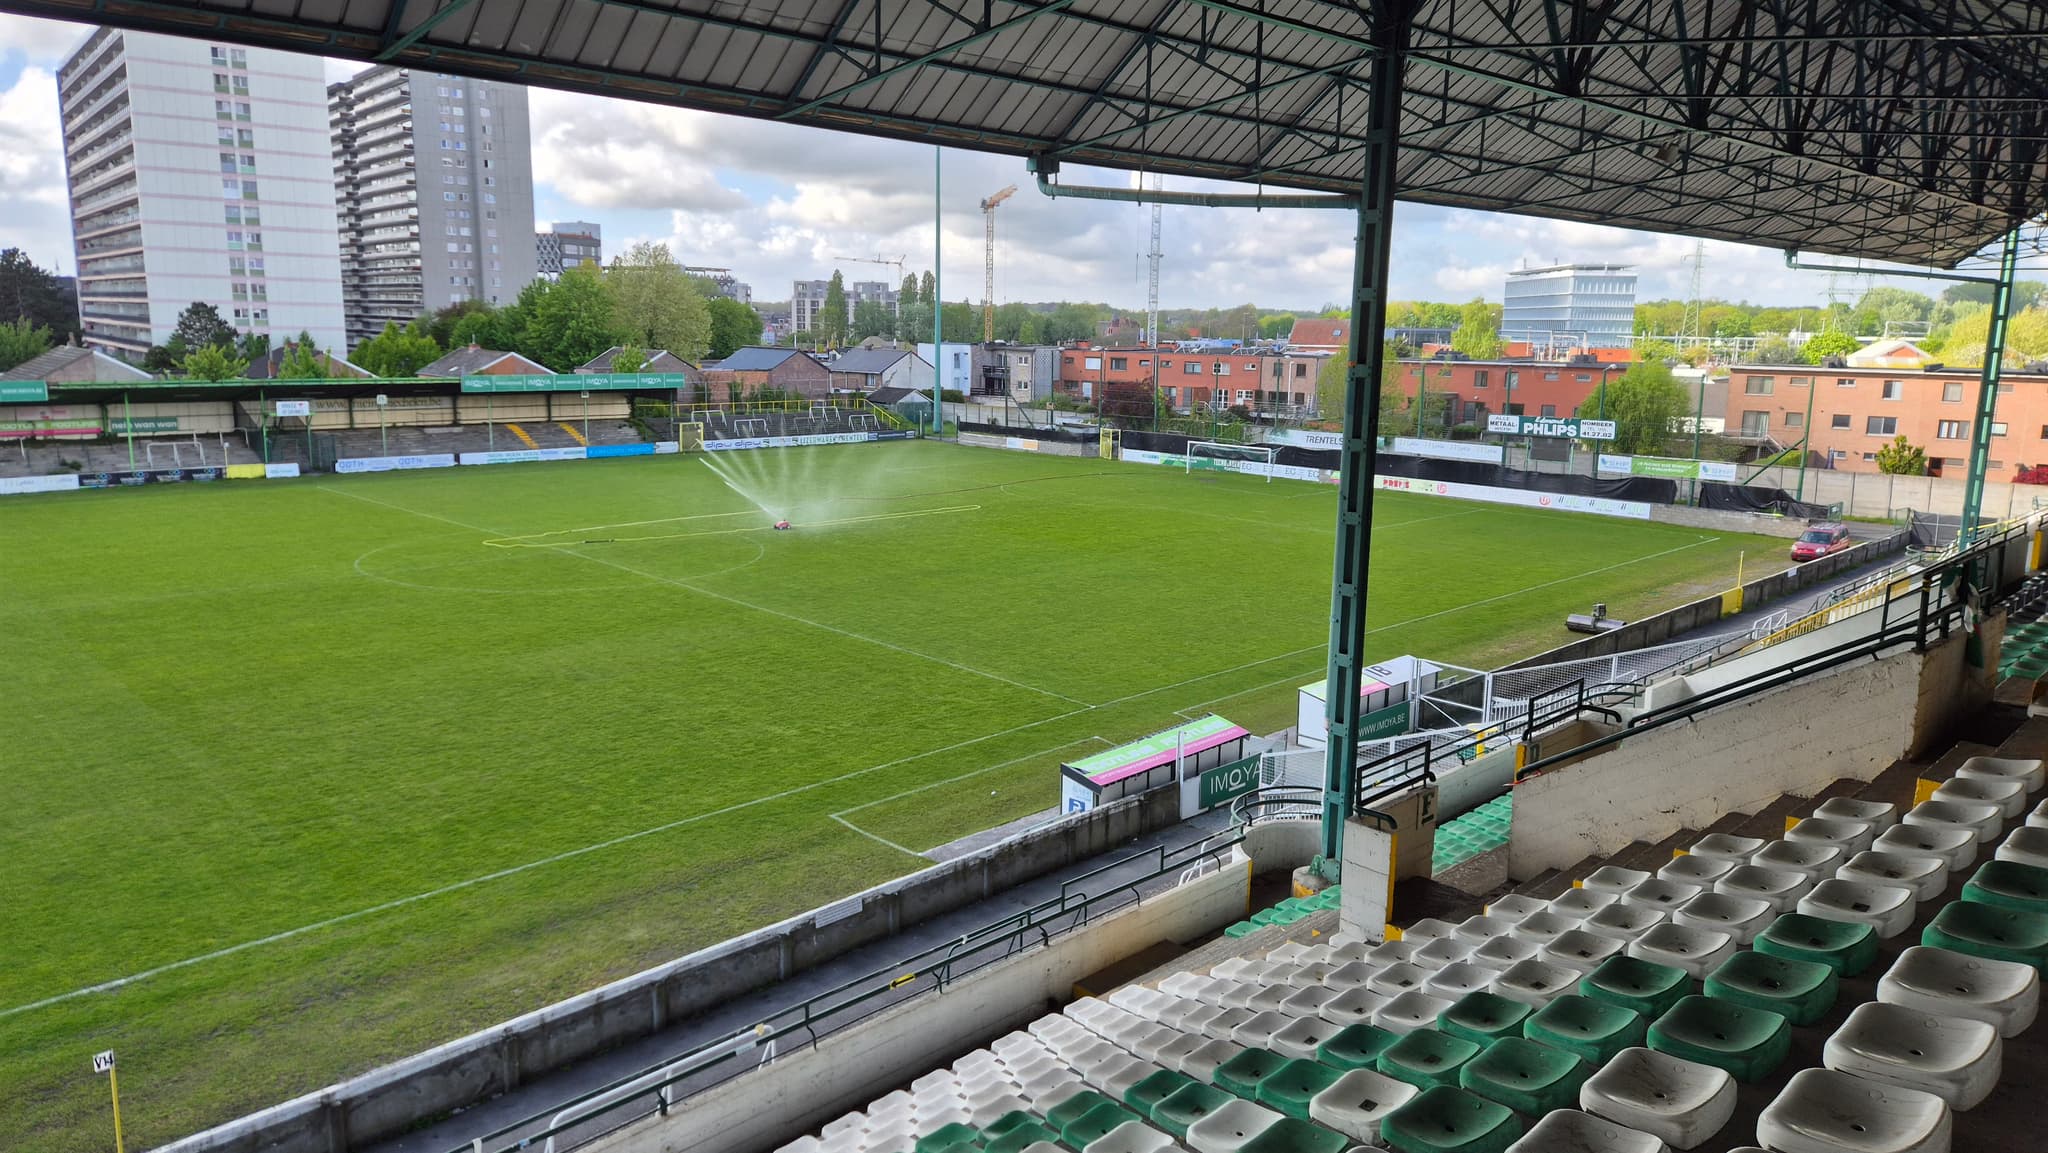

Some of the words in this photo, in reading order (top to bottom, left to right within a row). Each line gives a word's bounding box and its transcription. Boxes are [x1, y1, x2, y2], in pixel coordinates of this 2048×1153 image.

[1523, 422, 1577, 437] PHLIPS
[1359, 713, 1406, 737] WWW.IMOYA.BE
[1210, 761, 1260, 794] IMOYA
